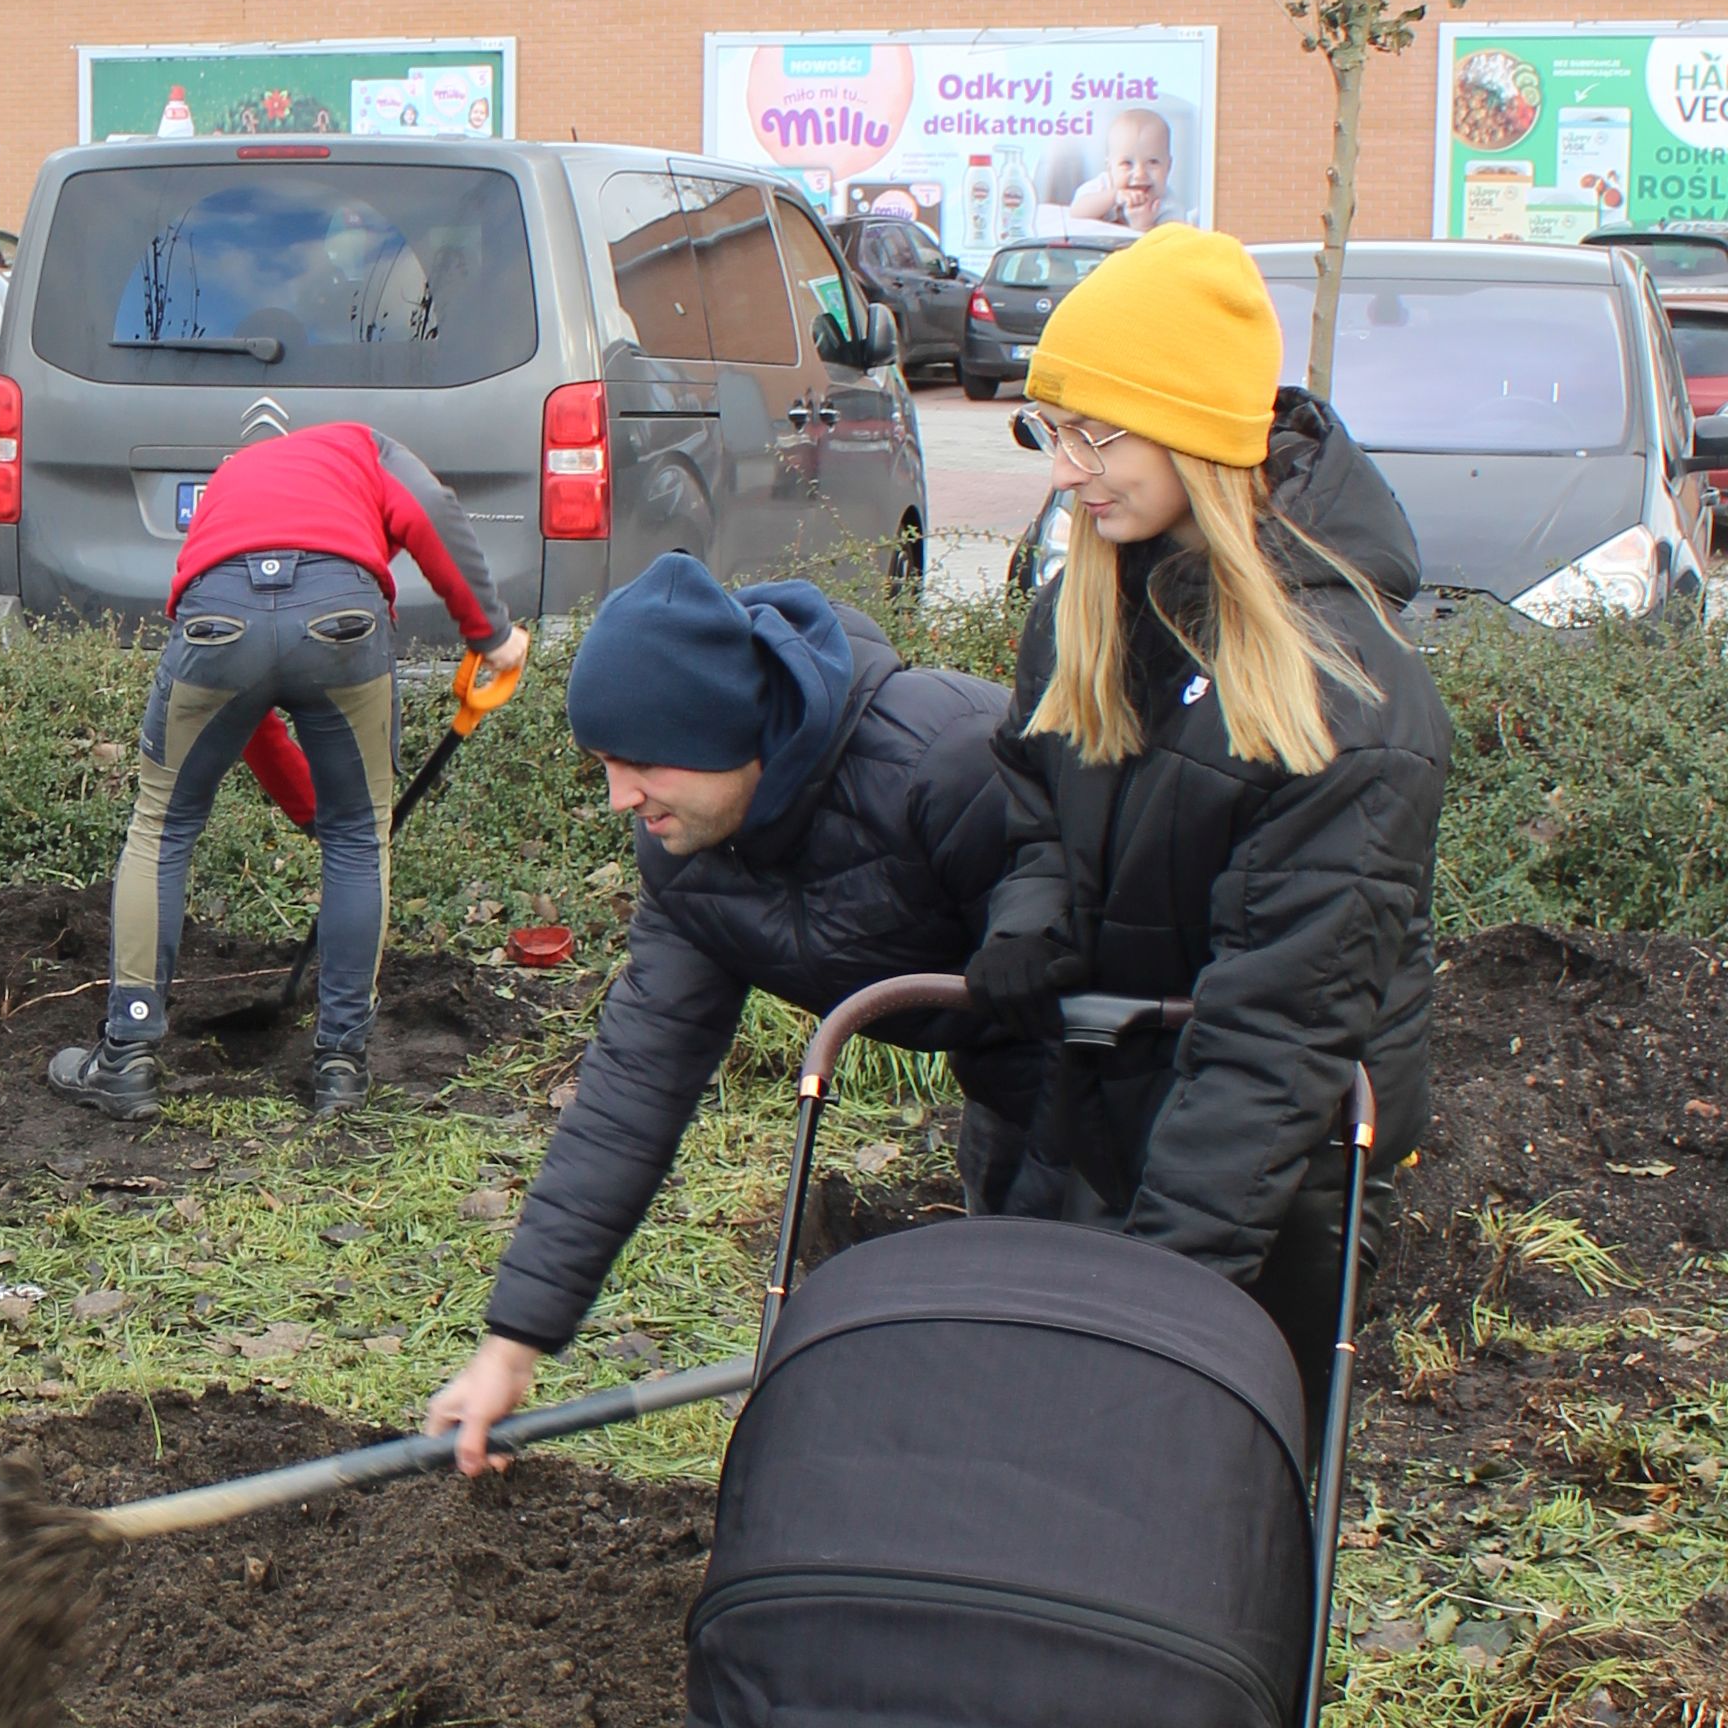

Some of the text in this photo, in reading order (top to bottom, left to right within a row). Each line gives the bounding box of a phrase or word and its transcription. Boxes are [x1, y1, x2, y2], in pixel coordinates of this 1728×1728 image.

[790, 56, 863, 73] NOWOŚĆ!
[783, 88, 815, 105] miło
[819, 86, 838, 99] mi
[938, 71, 1159, 106] Odkryj świat
[923, 110, 1094, 136] delikatności
[815, 176, 825, 190] 5
